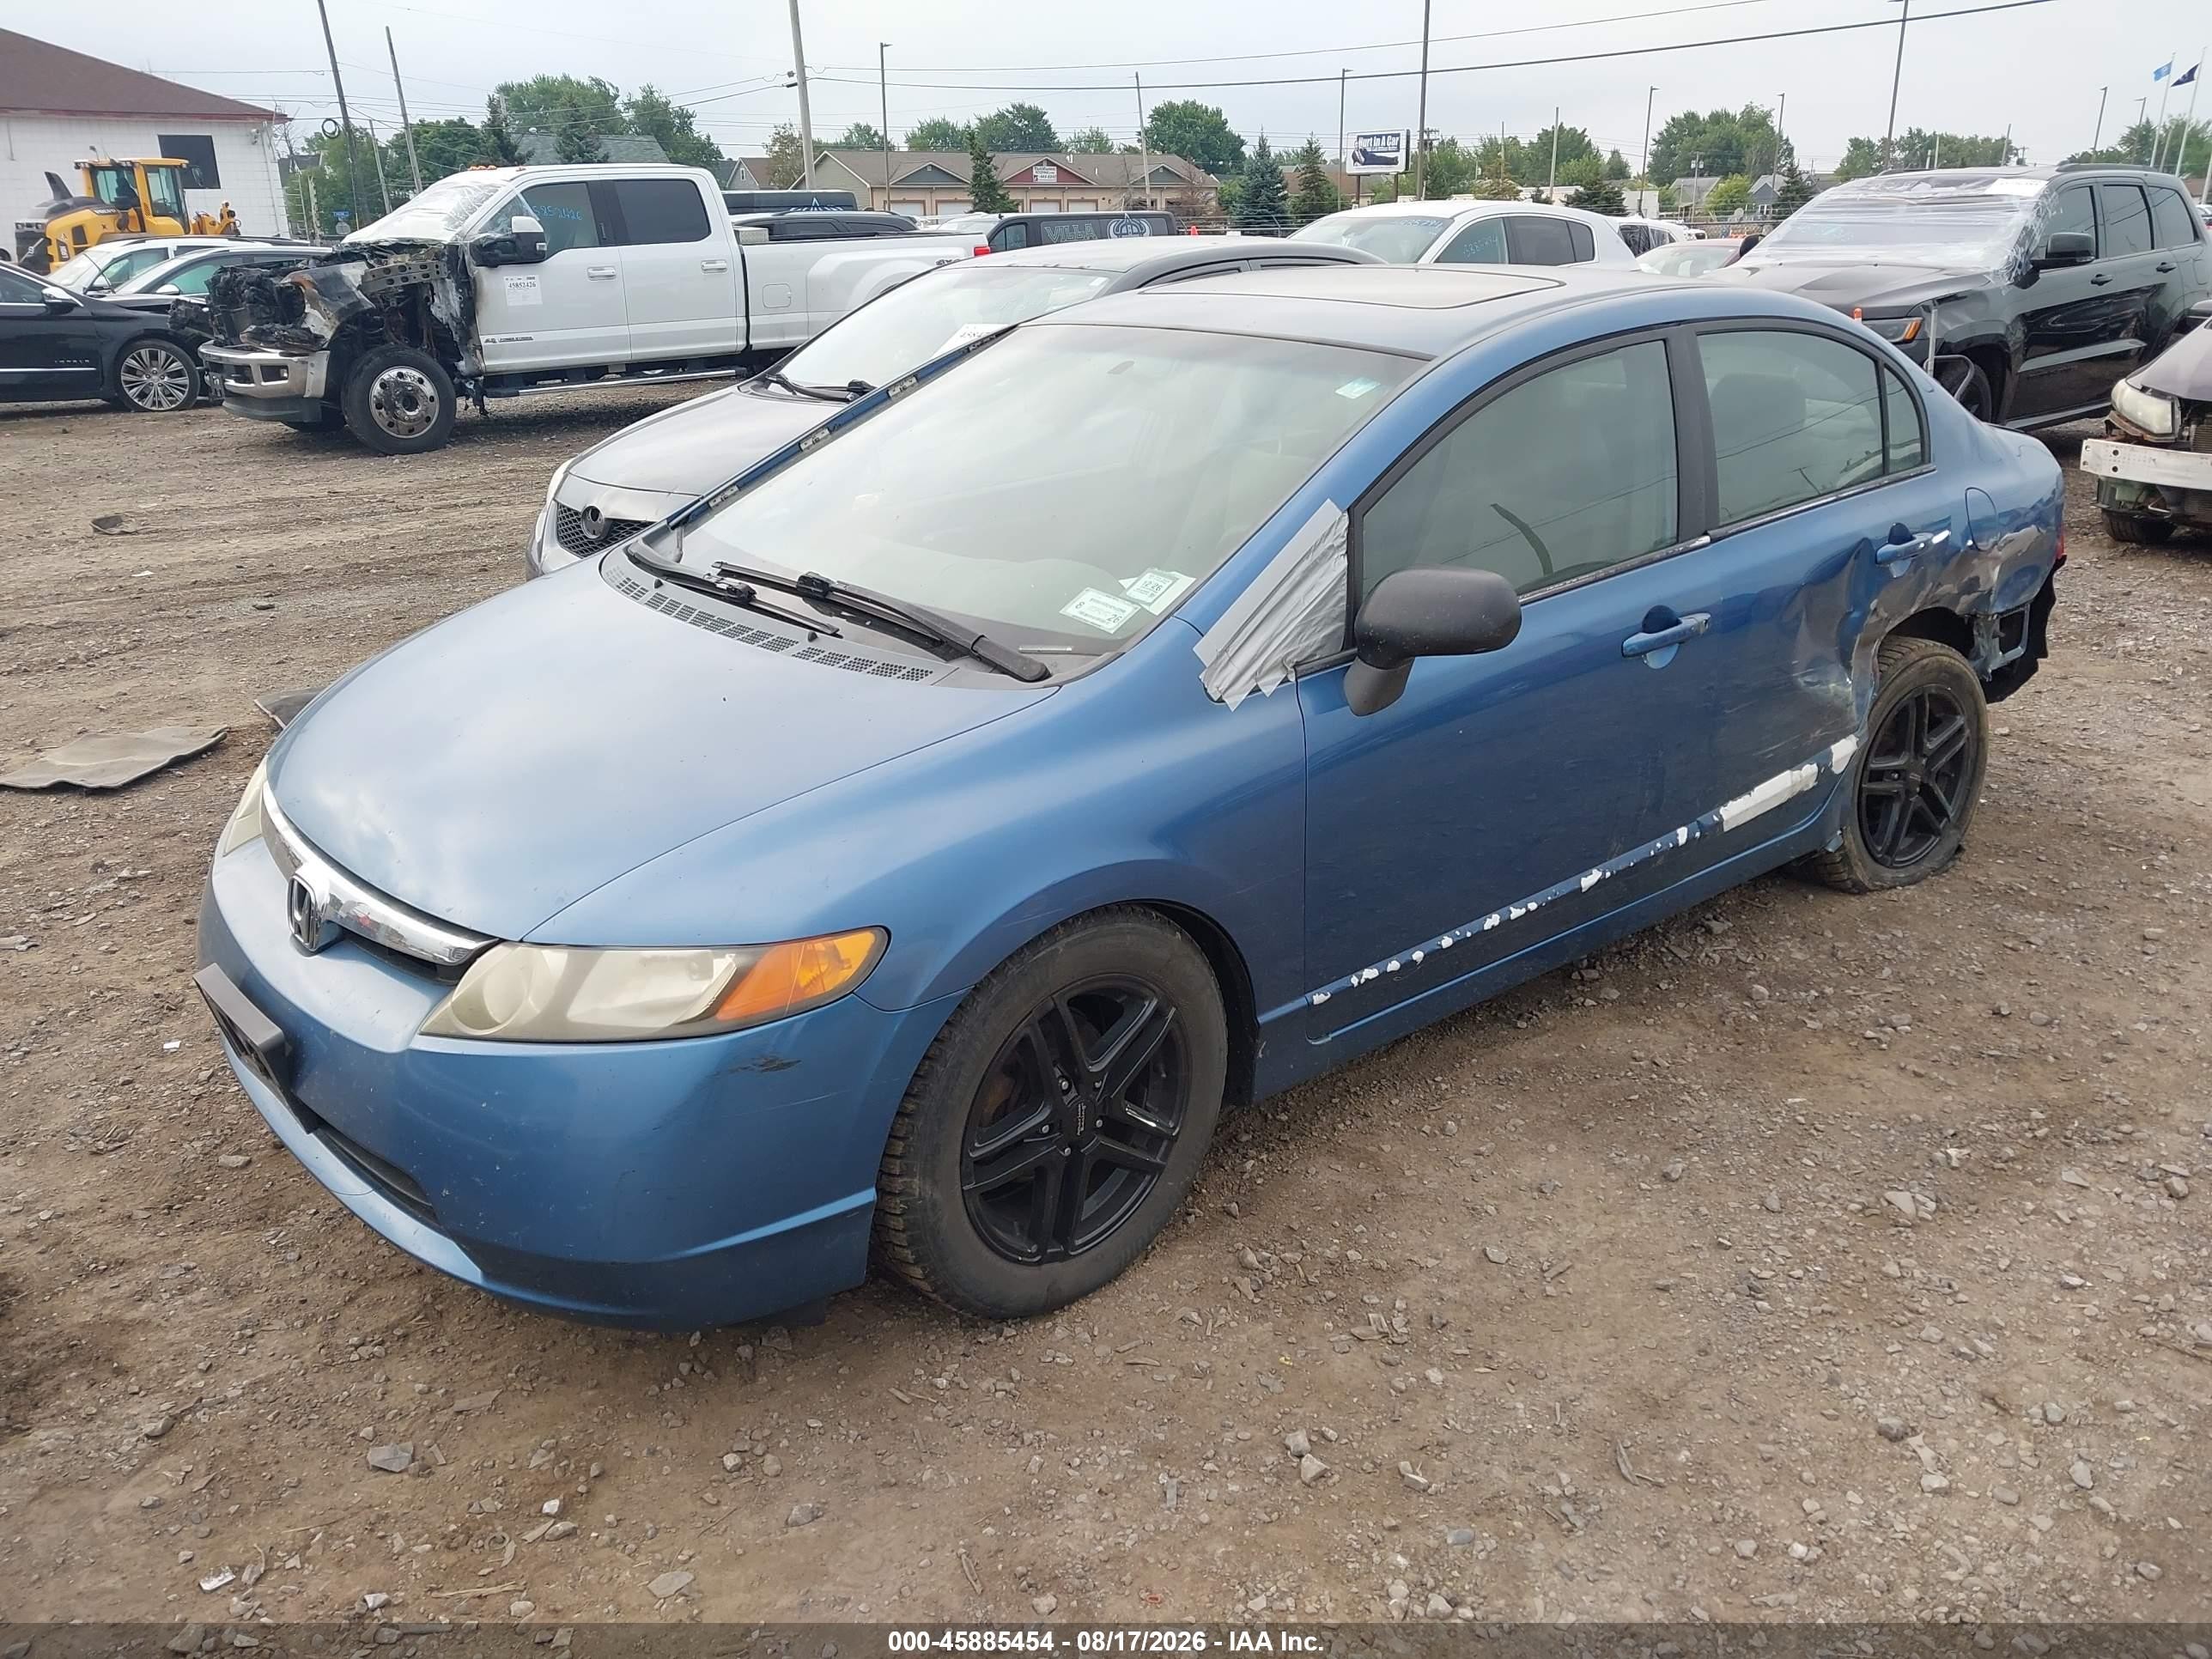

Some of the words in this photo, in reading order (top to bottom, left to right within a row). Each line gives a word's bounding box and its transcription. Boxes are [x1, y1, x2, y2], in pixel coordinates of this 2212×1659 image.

[1358, 137, 1373, 147] Hurt
[1373, 136, 1381, 146] In
[1381, 135, 1386, 146] A
[1387, 135, 1399, 146] Car
[1044, 223, 1098, 243] VILLA
